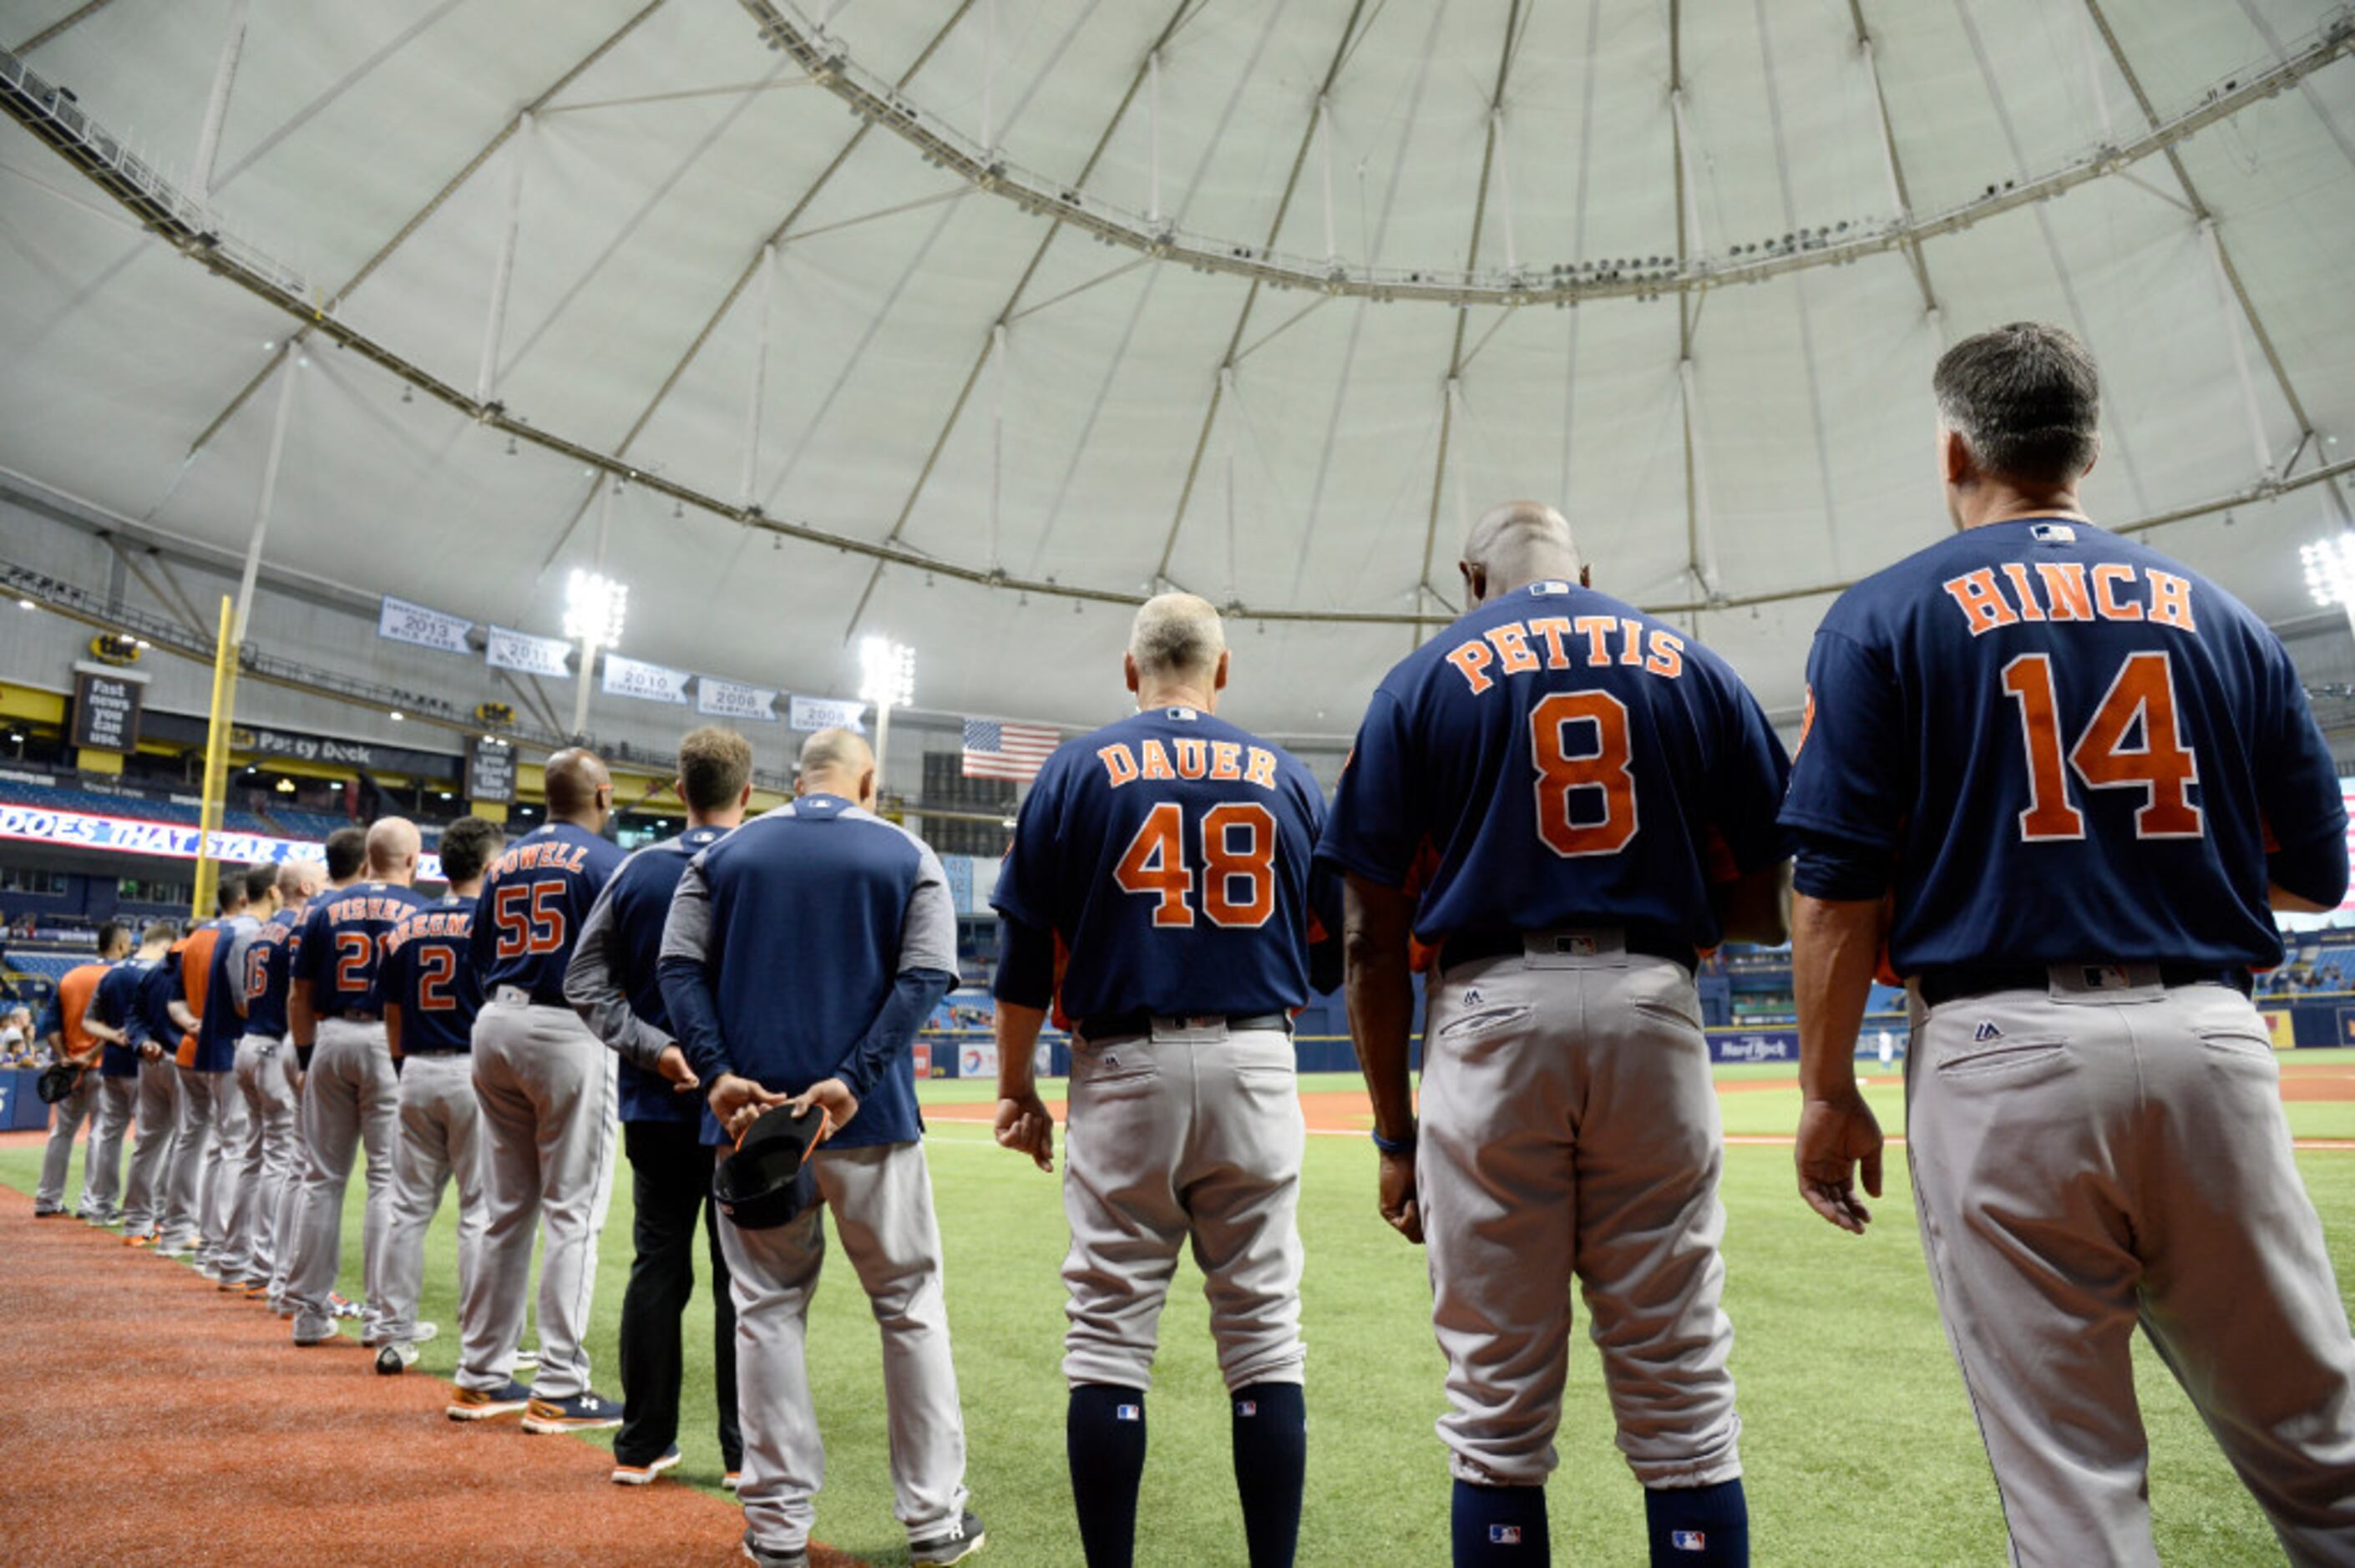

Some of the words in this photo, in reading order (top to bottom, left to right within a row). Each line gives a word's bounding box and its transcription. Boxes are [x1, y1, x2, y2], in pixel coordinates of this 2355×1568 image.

[1942, 563, 2196, 637] HINCH
[405, 615, 448, 637] 2013
[509, 643, 549, 663] 2011
[1446, 616, 1684, 695] PETTIS
[89, 694, 130, 711] news
[93, 679, 124, 697] Fast
[625, 670, 668, 690] 2010
[716, 690, 758, 707] 2008
[93, 720, 123, 735] can
[94, 708, 124, 723] you
[1096, 738, 1277, 790] DAUER
[2001, 650, 2204, 842] 14
[1529, 689, 1639, 858] 8
[0, 804, 95, 847] DOES
[109, 820, 196, 858] THAT
[198, 831, 278, 862] STAR
[490, 842, 589, 883] POWELL
[1113, 802, 1277, 928] 48
[494, 880, 566, 960] 55
[419, 944, 456, 1010] 2
